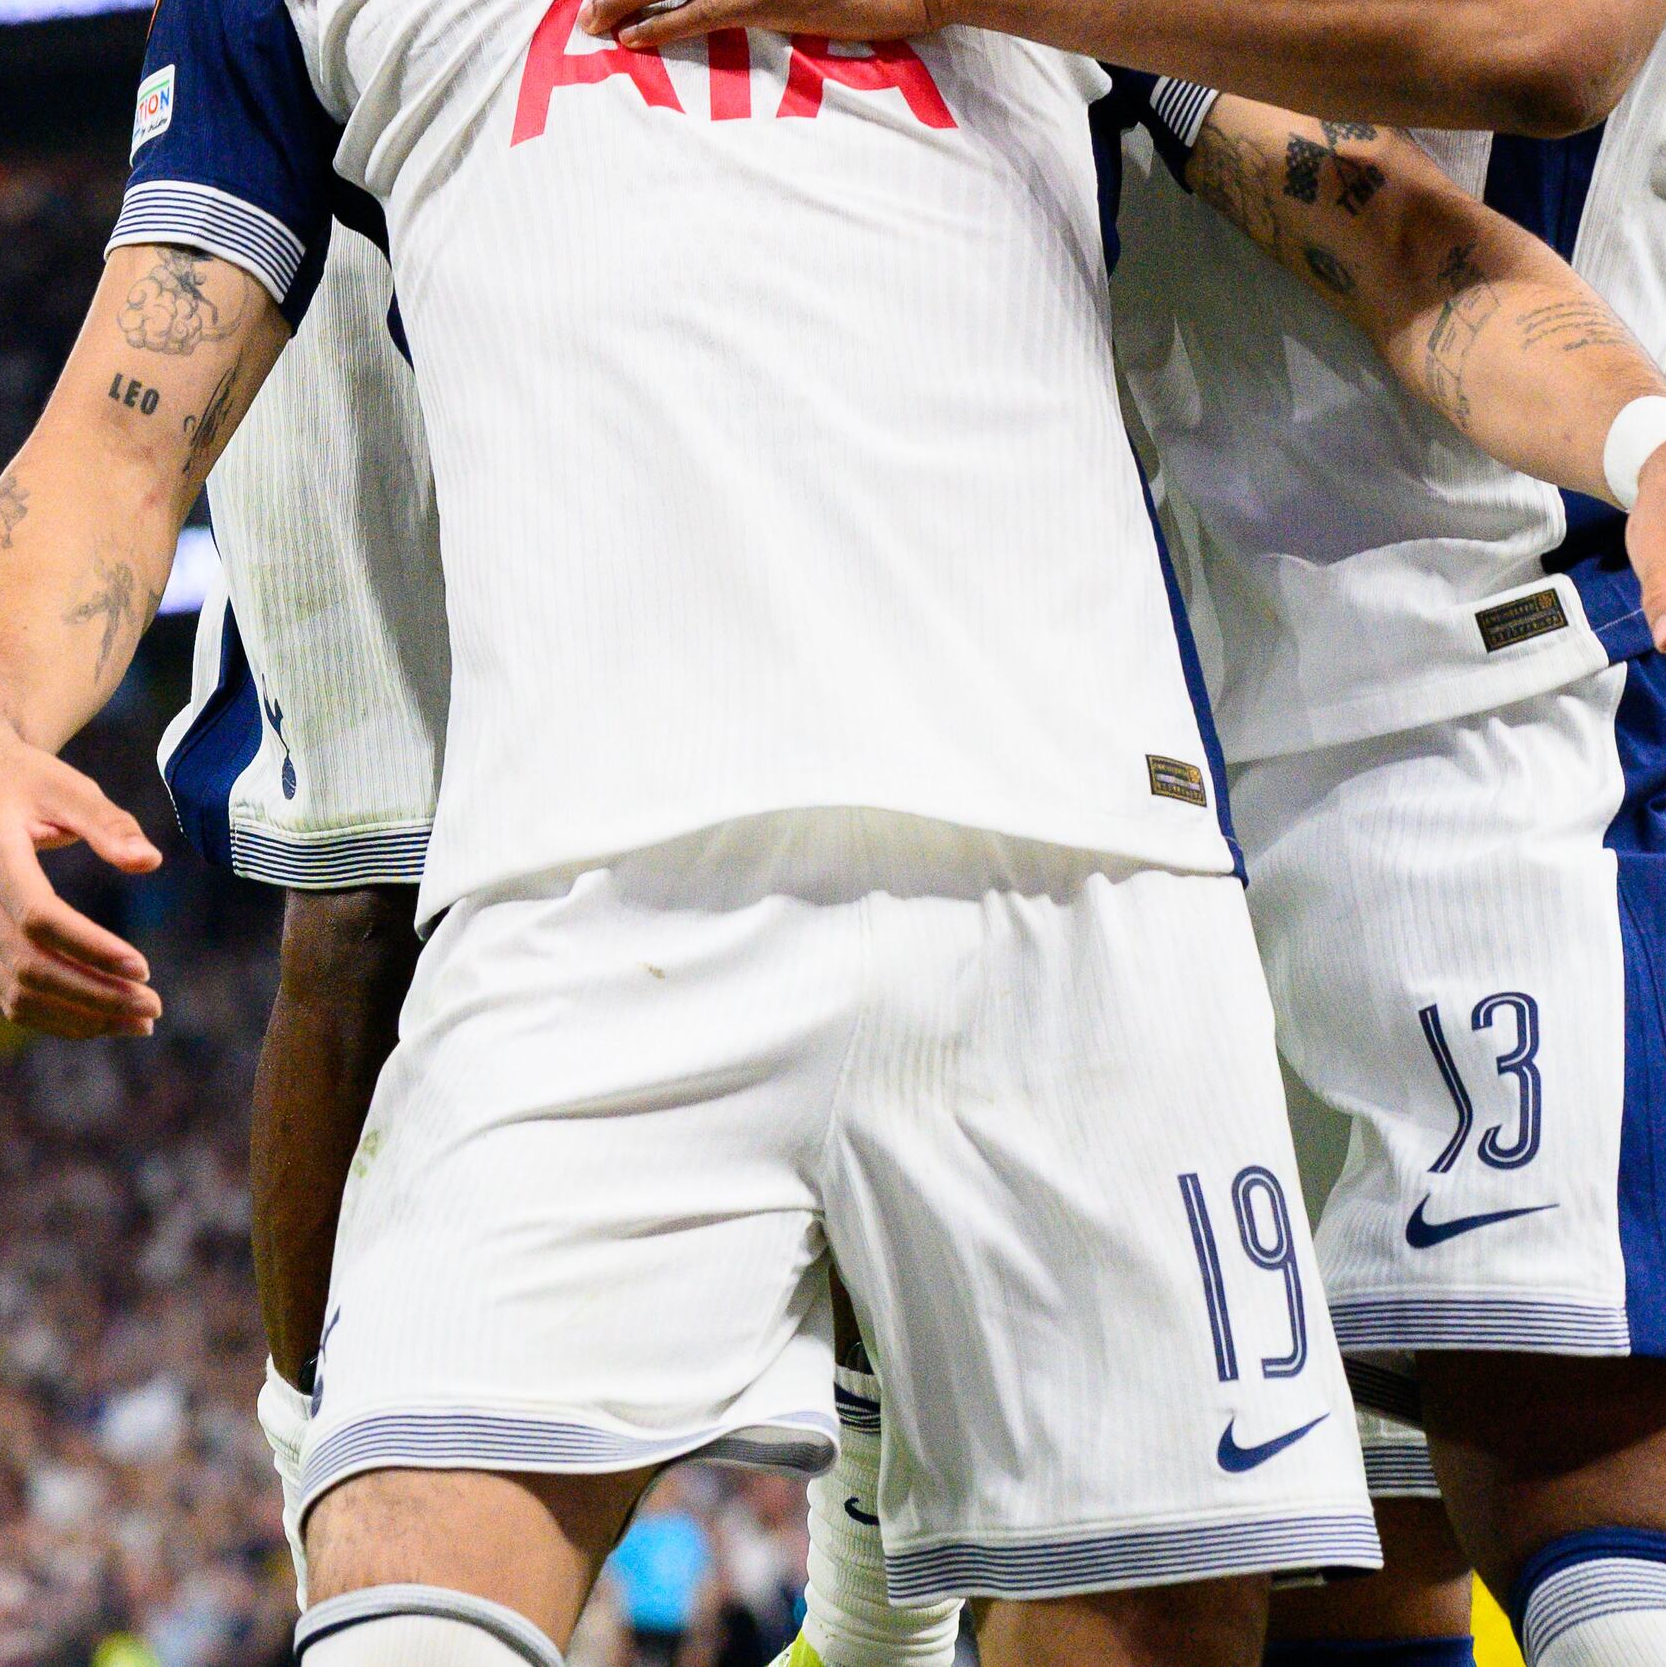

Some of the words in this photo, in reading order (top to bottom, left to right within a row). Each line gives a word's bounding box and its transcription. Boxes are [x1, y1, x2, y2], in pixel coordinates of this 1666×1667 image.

[108, 372, 161, 416] LEO
[1418, 991, 1542, 1174] 13
[1177, 1164, 1308, 1383] 19
